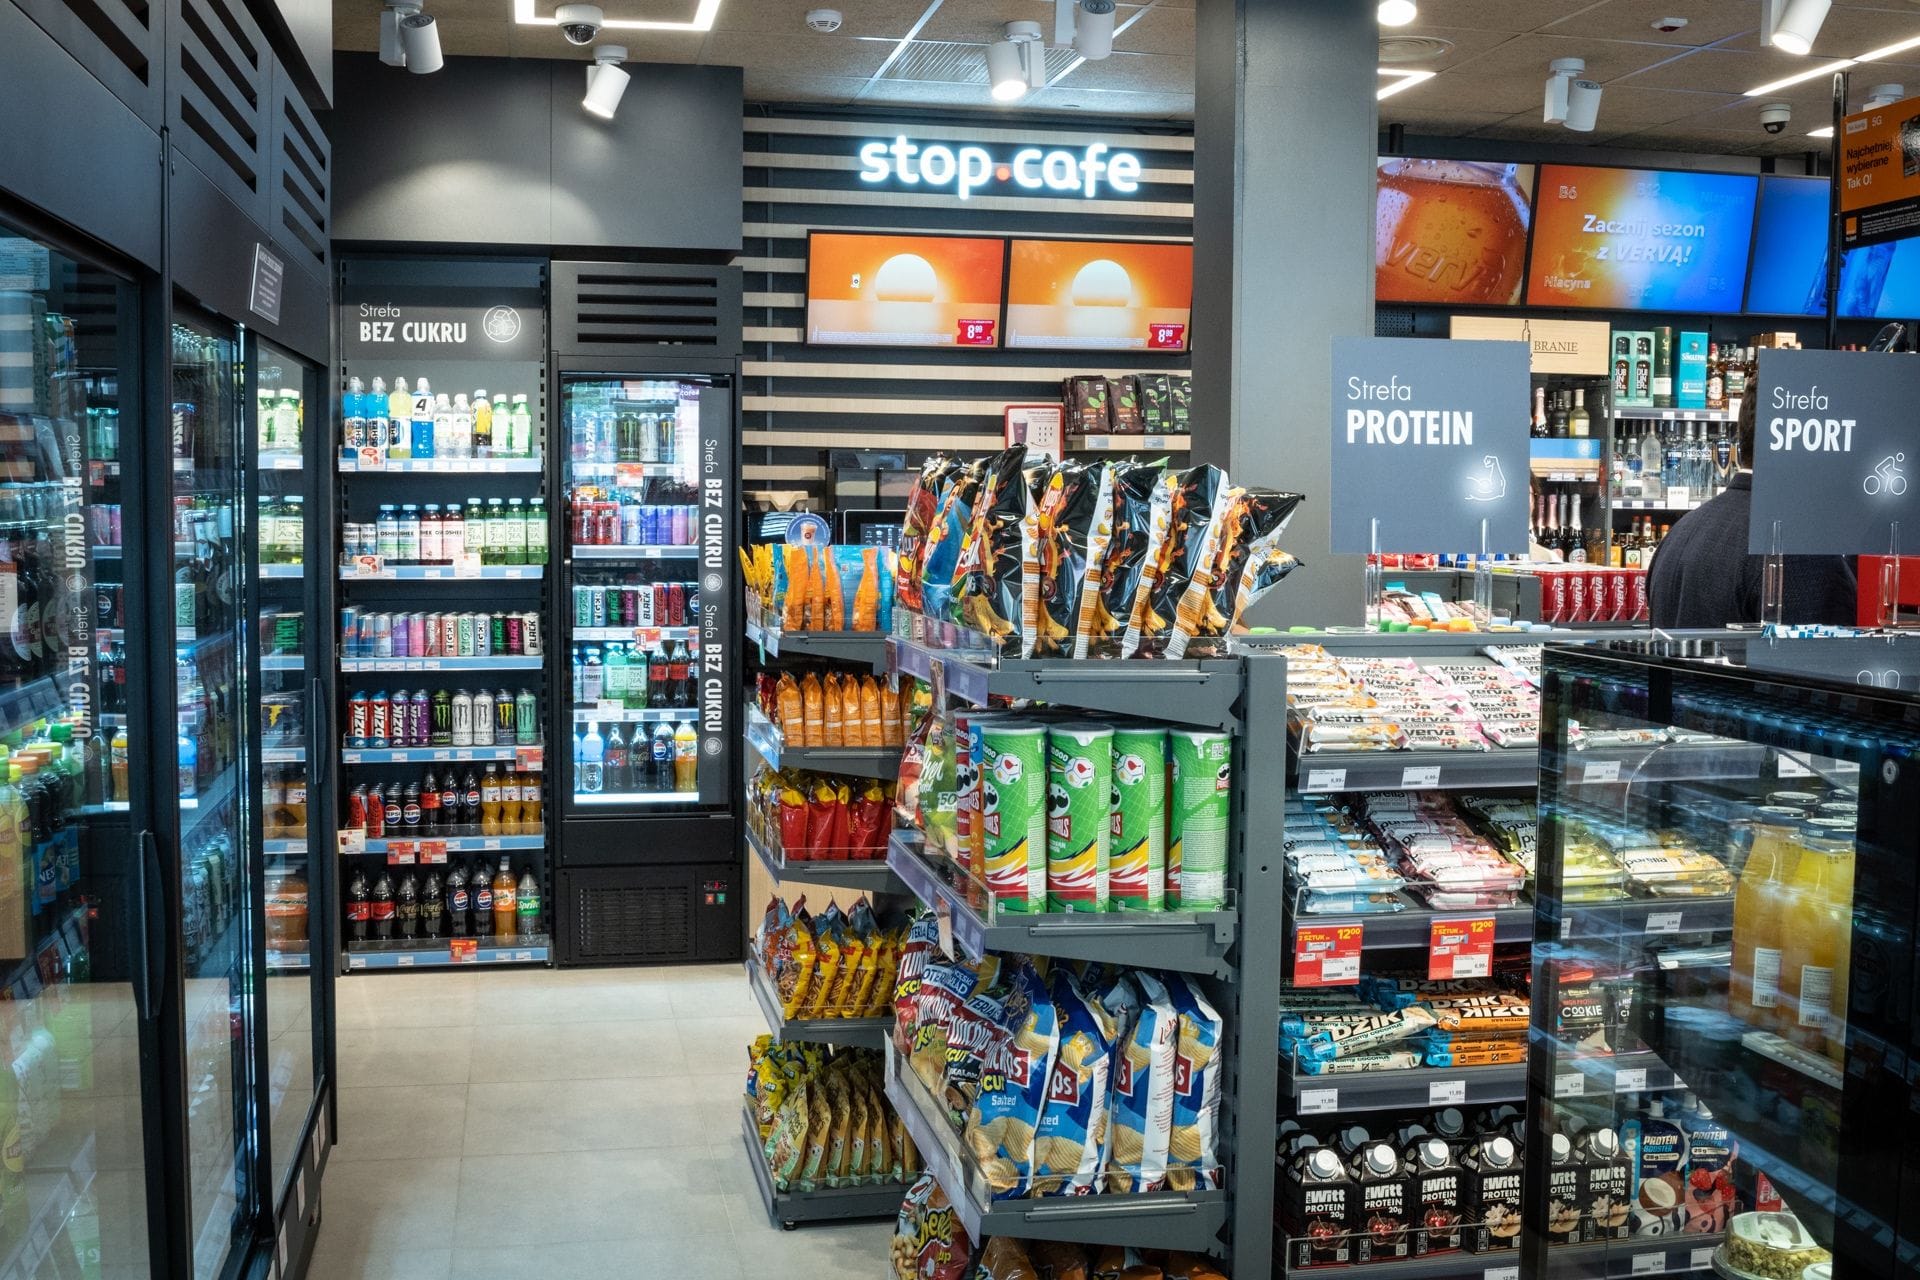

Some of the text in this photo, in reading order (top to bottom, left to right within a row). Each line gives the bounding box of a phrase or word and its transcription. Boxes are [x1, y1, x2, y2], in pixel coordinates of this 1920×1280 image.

[1846, 156, 1889, 175] wybierane
[1847, 174, 1873, 189] Tak O!
[1582, 214, 1706, 239] Zacznij sezon
[1596, 245, 1693, 267] z VERVĄ!
[1543, 276, 1591, 291] Niacyna
[359, 303, 400, 318] Strefa
[360, 322, 467, 343] BEZ CUKRU
[1347, 375, 1411, 400] Strefa
[1771, 386, 1829, 410] Strefa
[1347, 409, 1473, 445] PROTEIN
[1770, 418, 1856, 451] SPORT
[705, 439, 722, 568] Strefa BEZ CUKRU
[1556, 577, 1564, 607] verva
[1574, 577, 1584, 607] verva
[1595, 577, 1604, 607] verva
[1616, 577, 1625, 607] verva
[643, 591, 651, 621] BLACK
[529, 619, 537, 649] BLACK
[705, 605, 722, 732] Strefa BEZ CUKRU
[354, 705, 365, 738] DZIK
[374, 705, 385, 738] DZIK
[393, 704, 404, 738] DZIK
[1399, 980, 1468, 991] DZIK
[1433, 996, 1500, 1008] DZIK
[1460, 1006, 1530, 1018] DZIK
[1562, 1006, 1602, 1018] COOKIE
[1331, 1009, 1404, 1042] DZIK
[1370, 1023, 1404, 1036] coconut
[991, 1095, 1017, 1106] Salted
[1644, 1136, 1678, 1145] PROTEIN
[1692, 1131, 1728, 1140] PROTEIN
[1422, 1190, 1456, 1202] PROTEIN
[1482, 1189, 1520, 1200] PROTEIN
[1612, 1188, 1625, 1196] 20g
[1305, 1204, 1344, 1213] PROTEIN
[1364, 1198, 1402, 1208] PROTEIN
[1388, 1206, 1402, 1214] 20g
[1444, 1198, 1456, 1206] 20g
[1330, 1212, 1344, 1220] 20g
